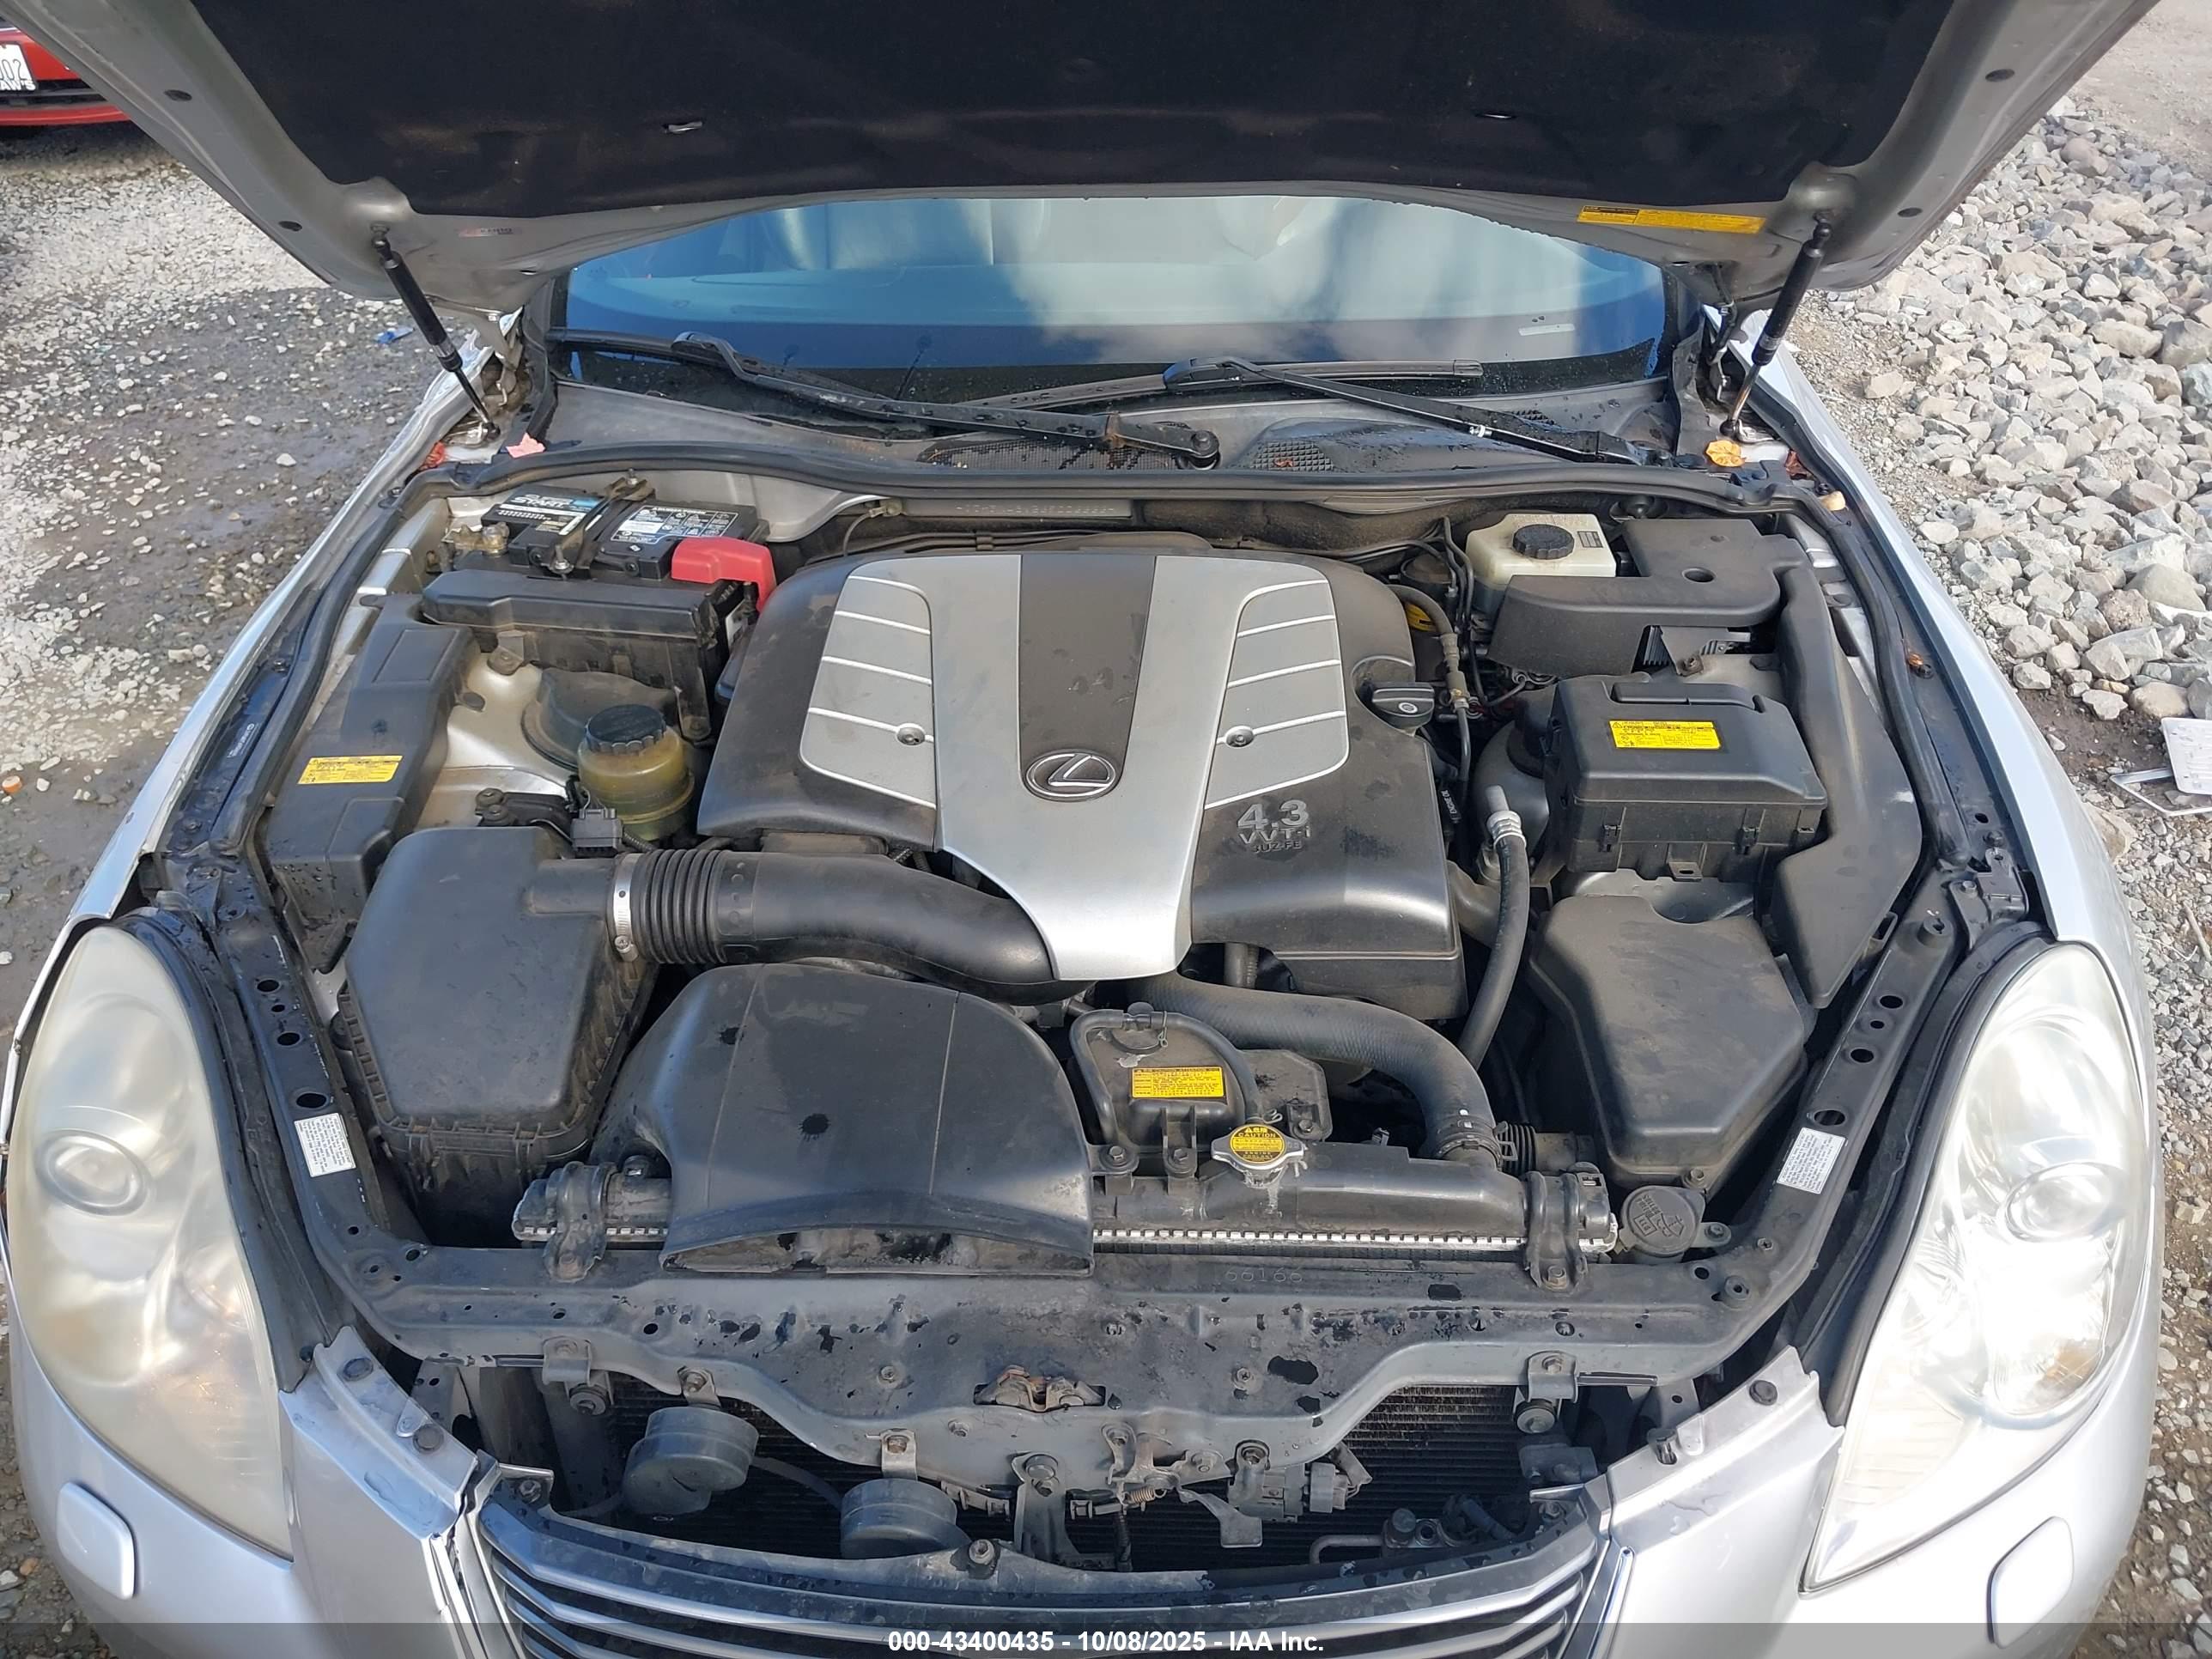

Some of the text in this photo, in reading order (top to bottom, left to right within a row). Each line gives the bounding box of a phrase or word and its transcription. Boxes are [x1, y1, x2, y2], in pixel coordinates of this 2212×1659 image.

[0, 58, 27, 81] 02
[1237, 799, 1310, 830] 4.3
[1239, 824, 1311, 844] VVT-i
[1224, 1267, 1304, 1282] 66166
